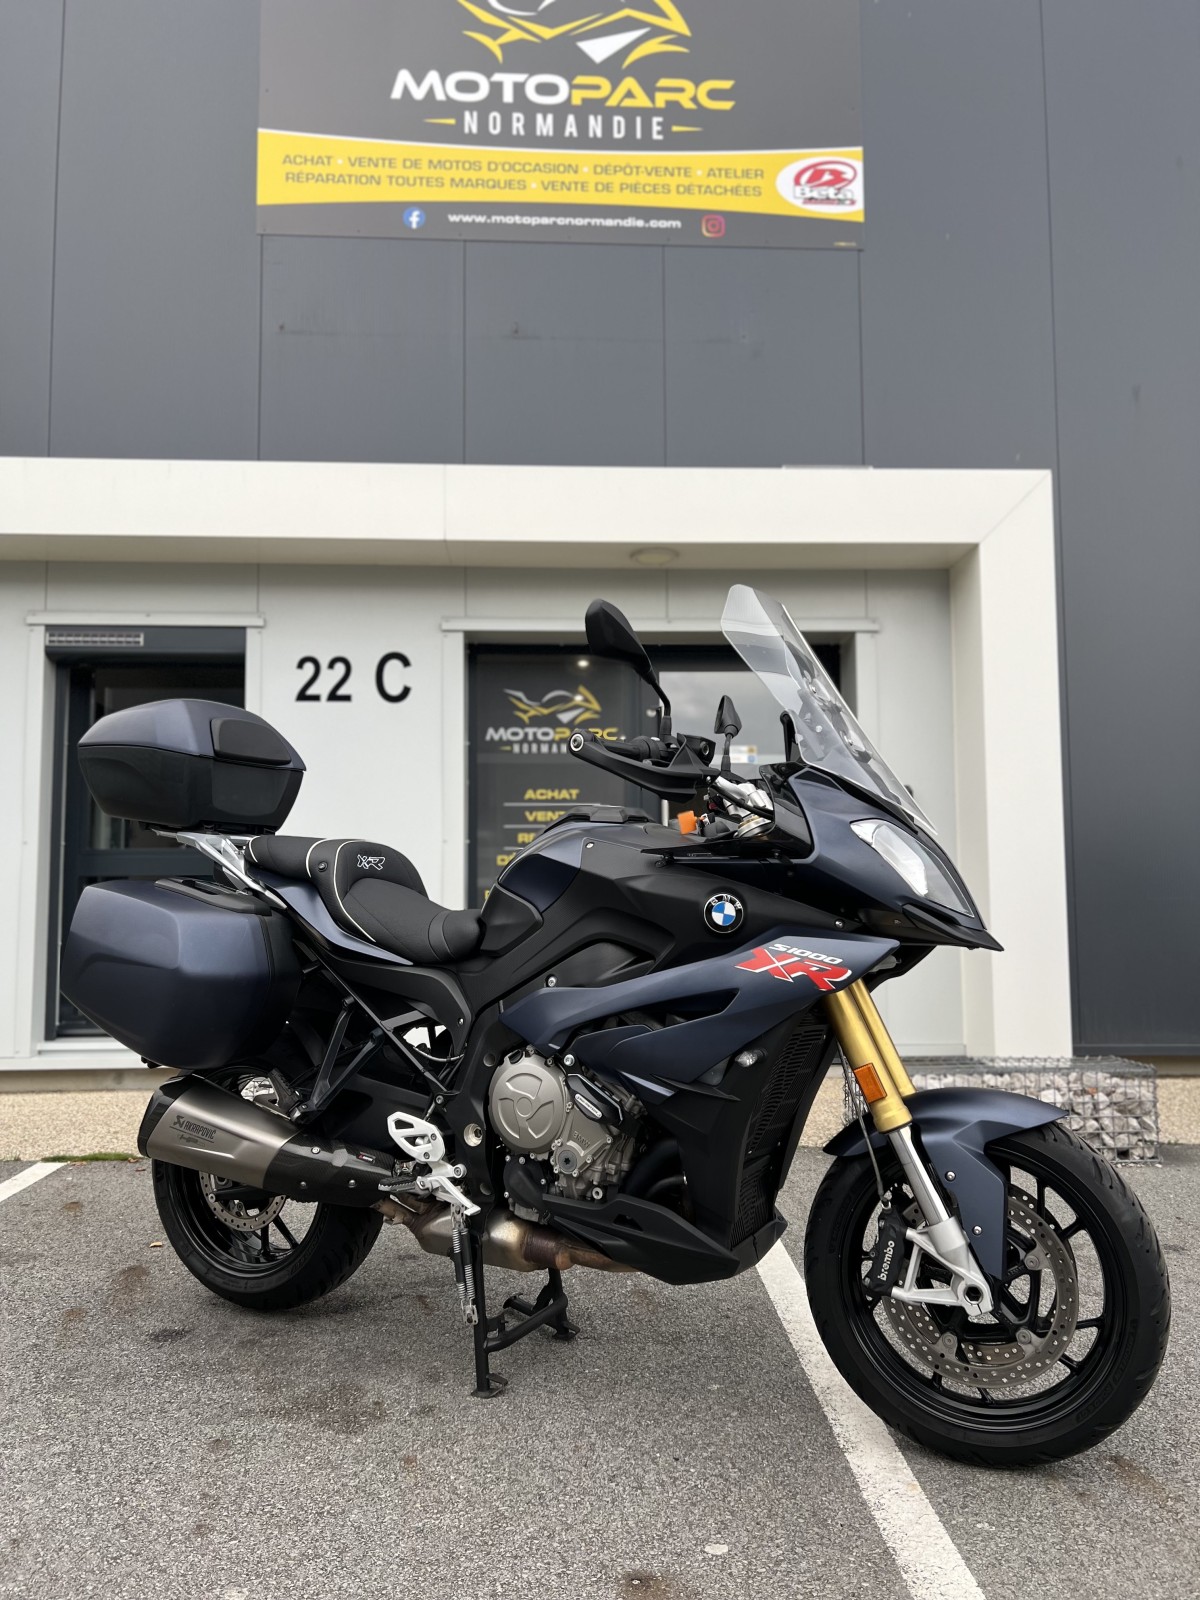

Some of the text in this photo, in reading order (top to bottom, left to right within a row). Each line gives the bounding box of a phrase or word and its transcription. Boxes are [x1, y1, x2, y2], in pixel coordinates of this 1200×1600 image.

[389, 68, 736, 111] MOTOPARC
[463, 110, 665, 140] NORMANDIE
[282, 154, 764, 180] ACHAT VENTE DE MOTOS D'OCCASION DÉPÔT-VENTE ATELIER
[285, 170, 763, 197] RÉPARATION TOUTES MARQUES VENTE DE PIÈCES DÉTACHÉES
[447, 213, 682, 229] www.motoparcnormandie.com
[295, 651, 412, 704] 22 C
[485, 726, 619, 742] MOTOPRC
[512, 742, 567, 755] NORMAN
[524, 788, 579, 800] ACHAT
[357, 854, 386, 871] XR
[769, 943, 843, 965] S1000
[734, 947, 853, 992] XR
[877, 1240, 895, 1281] brembo
